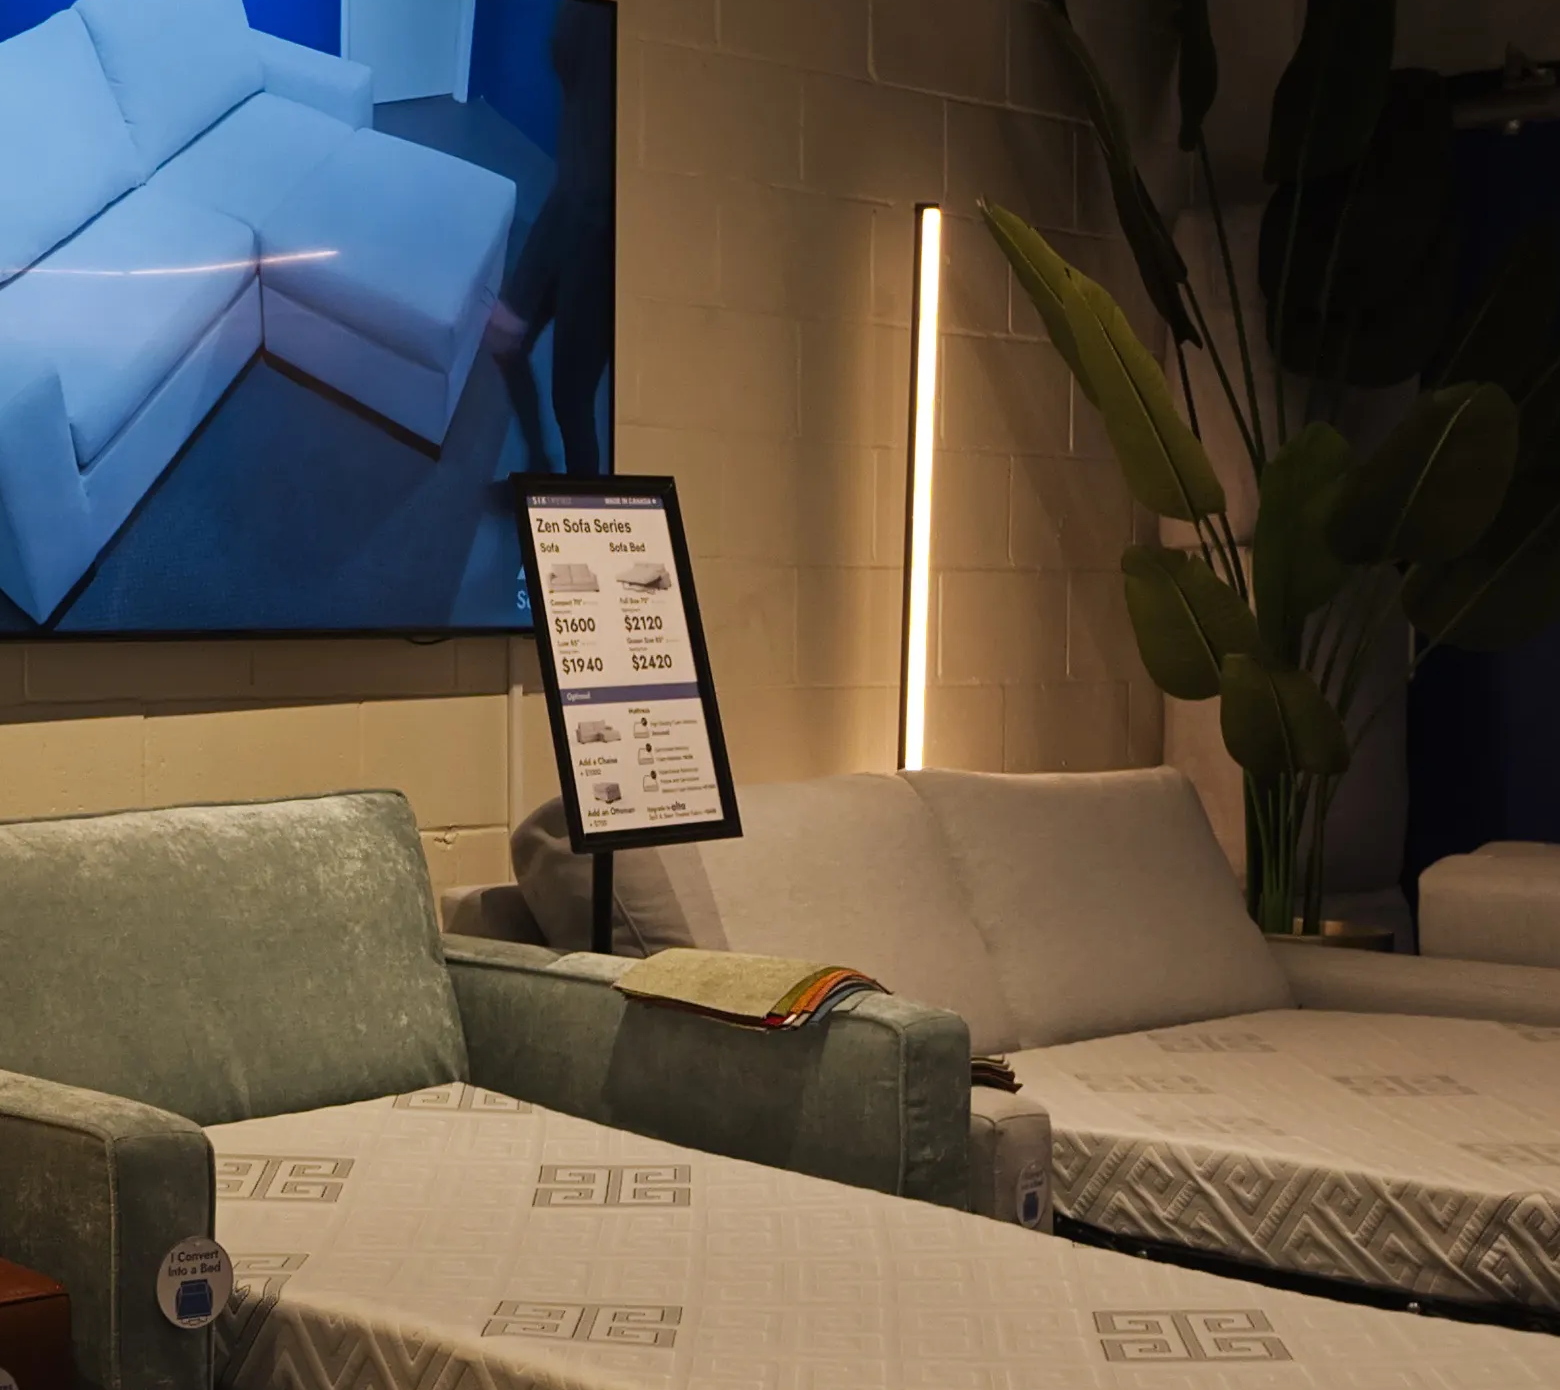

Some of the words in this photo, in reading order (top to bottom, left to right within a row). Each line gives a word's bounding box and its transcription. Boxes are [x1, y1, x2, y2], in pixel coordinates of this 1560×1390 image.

[536, 517, 560, 533] Zen
[563, 518, 591, 533] Sofa
[594, 518, 632, 533] Series
[540, 542, 559, 553] Sofa
[609, 542, 627, 552] Sofa
[629, 542, 646, 552] Bed
[555, 617, 596, 635] $1600
[624, 615, 663, 633] $2120
[562, 657, 603, 675] $1940
[632, 653, 672, 671] $2420
[170, 1253, 174, 1263] I
[178, 1250, 220, 1263] Convert
[168, 1265, 188, 1277] Into
[190, 1267, 197, 1275] a
[200, 1259, 221, 1273] Bed
